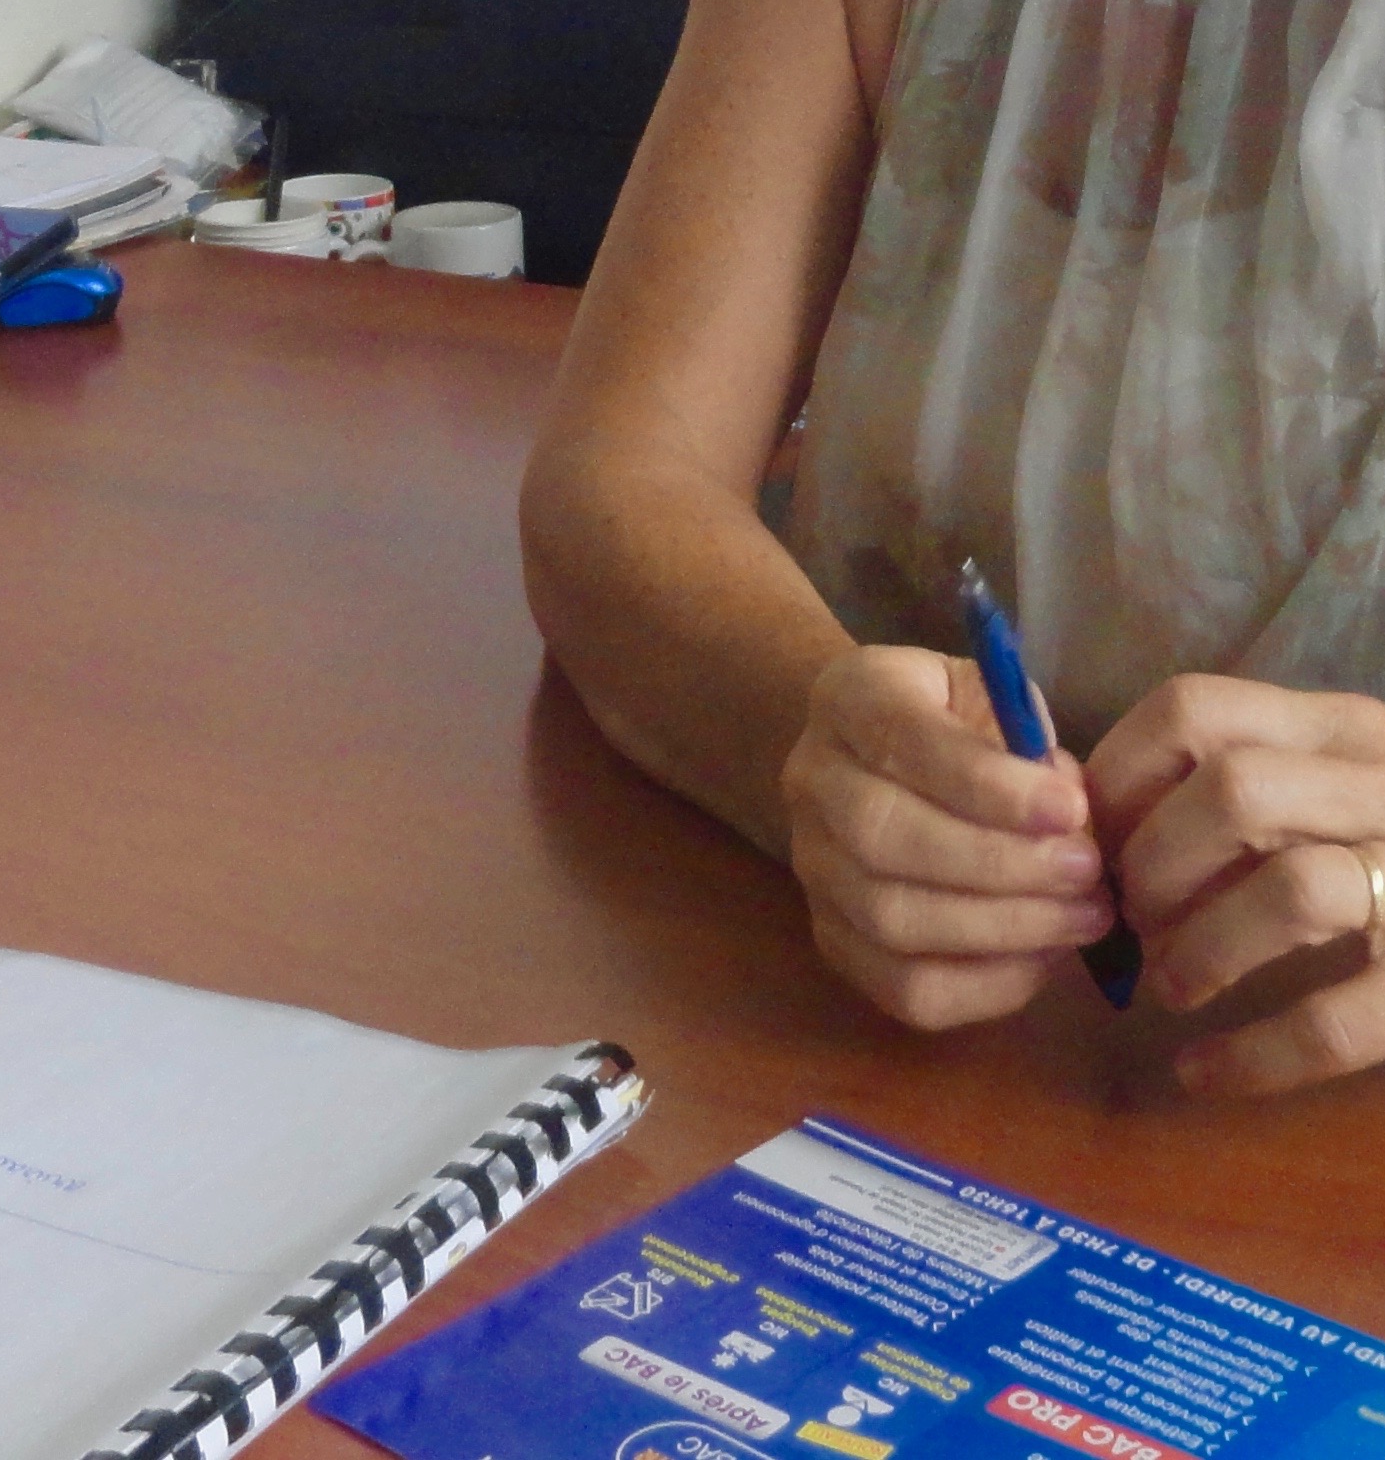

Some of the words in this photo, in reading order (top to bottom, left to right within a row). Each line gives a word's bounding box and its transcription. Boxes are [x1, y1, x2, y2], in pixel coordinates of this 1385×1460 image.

[1121, 1250, 1157, 1273] DE
[1173, 1272, 1296, 1331] VENDREDI
[1300, 1324, 1343, 1347] AU
[603, 1346, 664, 1381] BAC
[663, 1373, 693, 1395] le
[691, 1387, 773, 1433] Après
[1007, 1389, 1084, 1432] PRO
[1081, 1423, 1163, 1460] BAC
